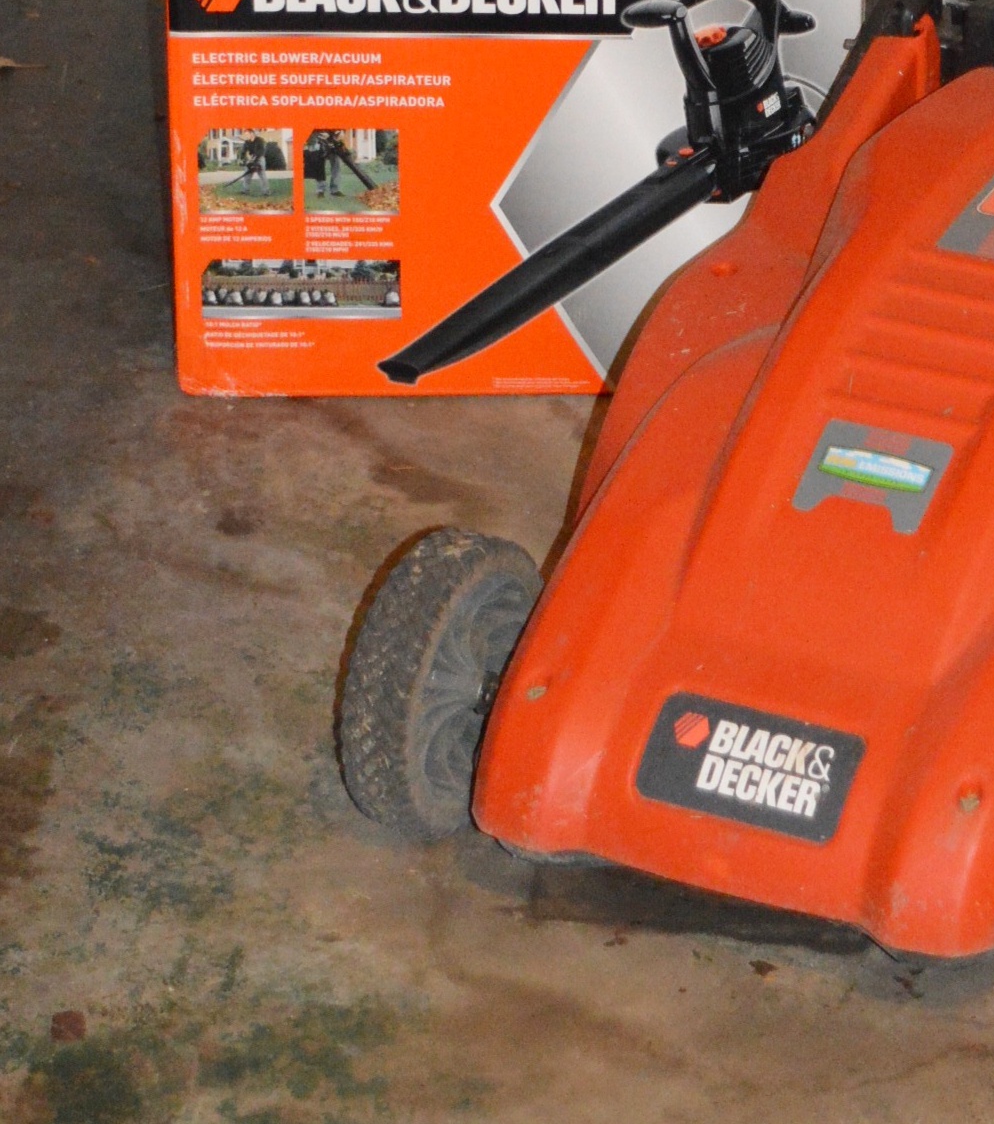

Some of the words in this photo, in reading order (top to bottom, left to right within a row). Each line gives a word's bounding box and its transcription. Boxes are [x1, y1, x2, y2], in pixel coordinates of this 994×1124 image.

[192, 53, 258, 64] ELECTRIC
[261, 52, 382, 65] BLOWER/VACUUM
[193, 72, 277, 86] ÉLECTRIQUE
[280, 74, 452, 86] SOUFFLEUR/ASPIRATEUR
[193, 93, 269, 107] ELÉCTRICA
[271, 95, 445, 108] SOPLADORA/ASPIRADORA
[695, 753, 822, 818] DECKER
